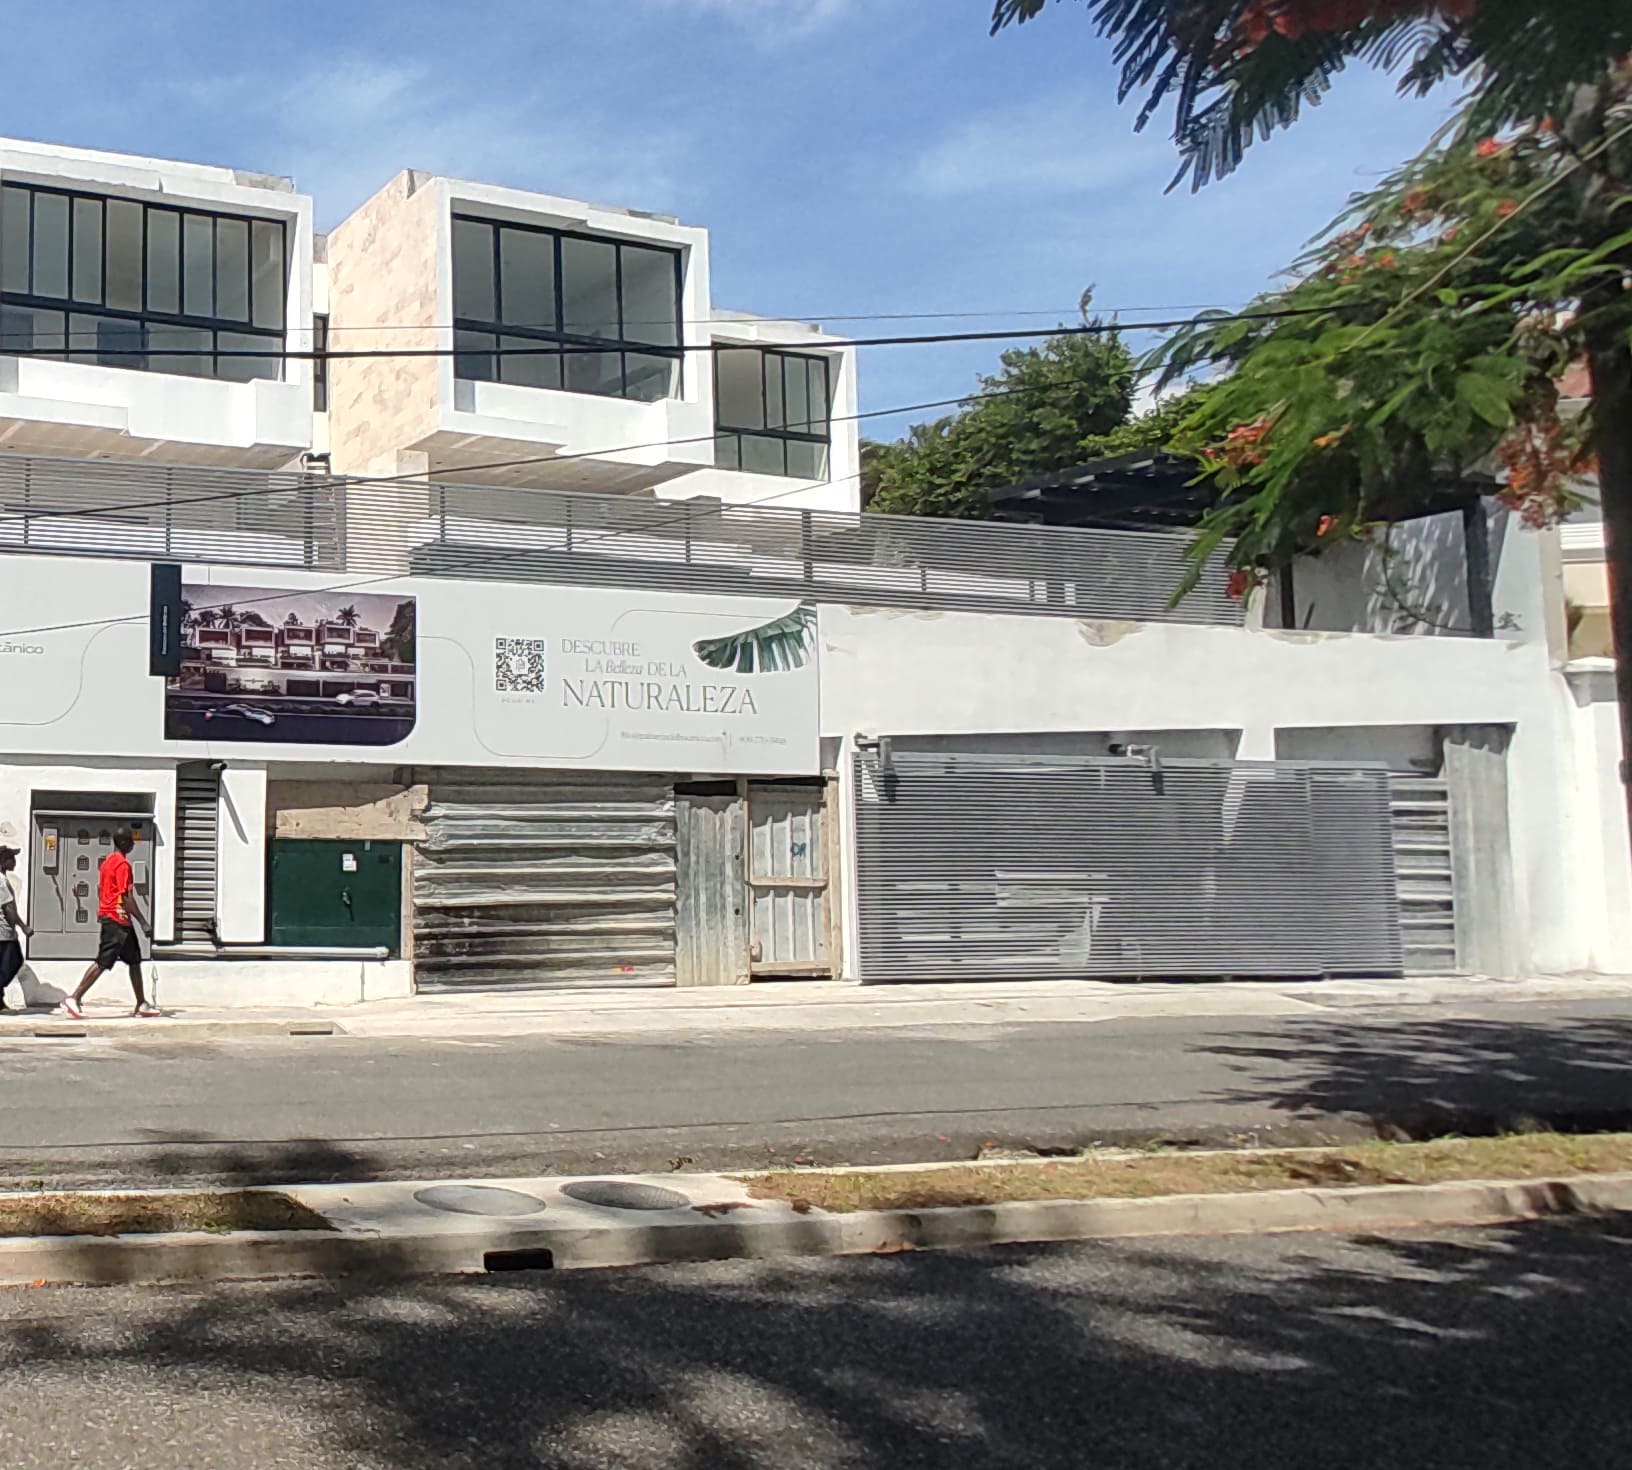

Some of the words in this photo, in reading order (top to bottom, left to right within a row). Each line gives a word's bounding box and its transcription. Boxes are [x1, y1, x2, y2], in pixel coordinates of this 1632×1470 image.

[561, 638, 641, 657] DESCUBRE
[585, 658, 604, 673] LA
[647, 661, 667, 677] DE
[669, 662, 688, 678] LA
[562, 678, 758, 715] NATURALEZA
